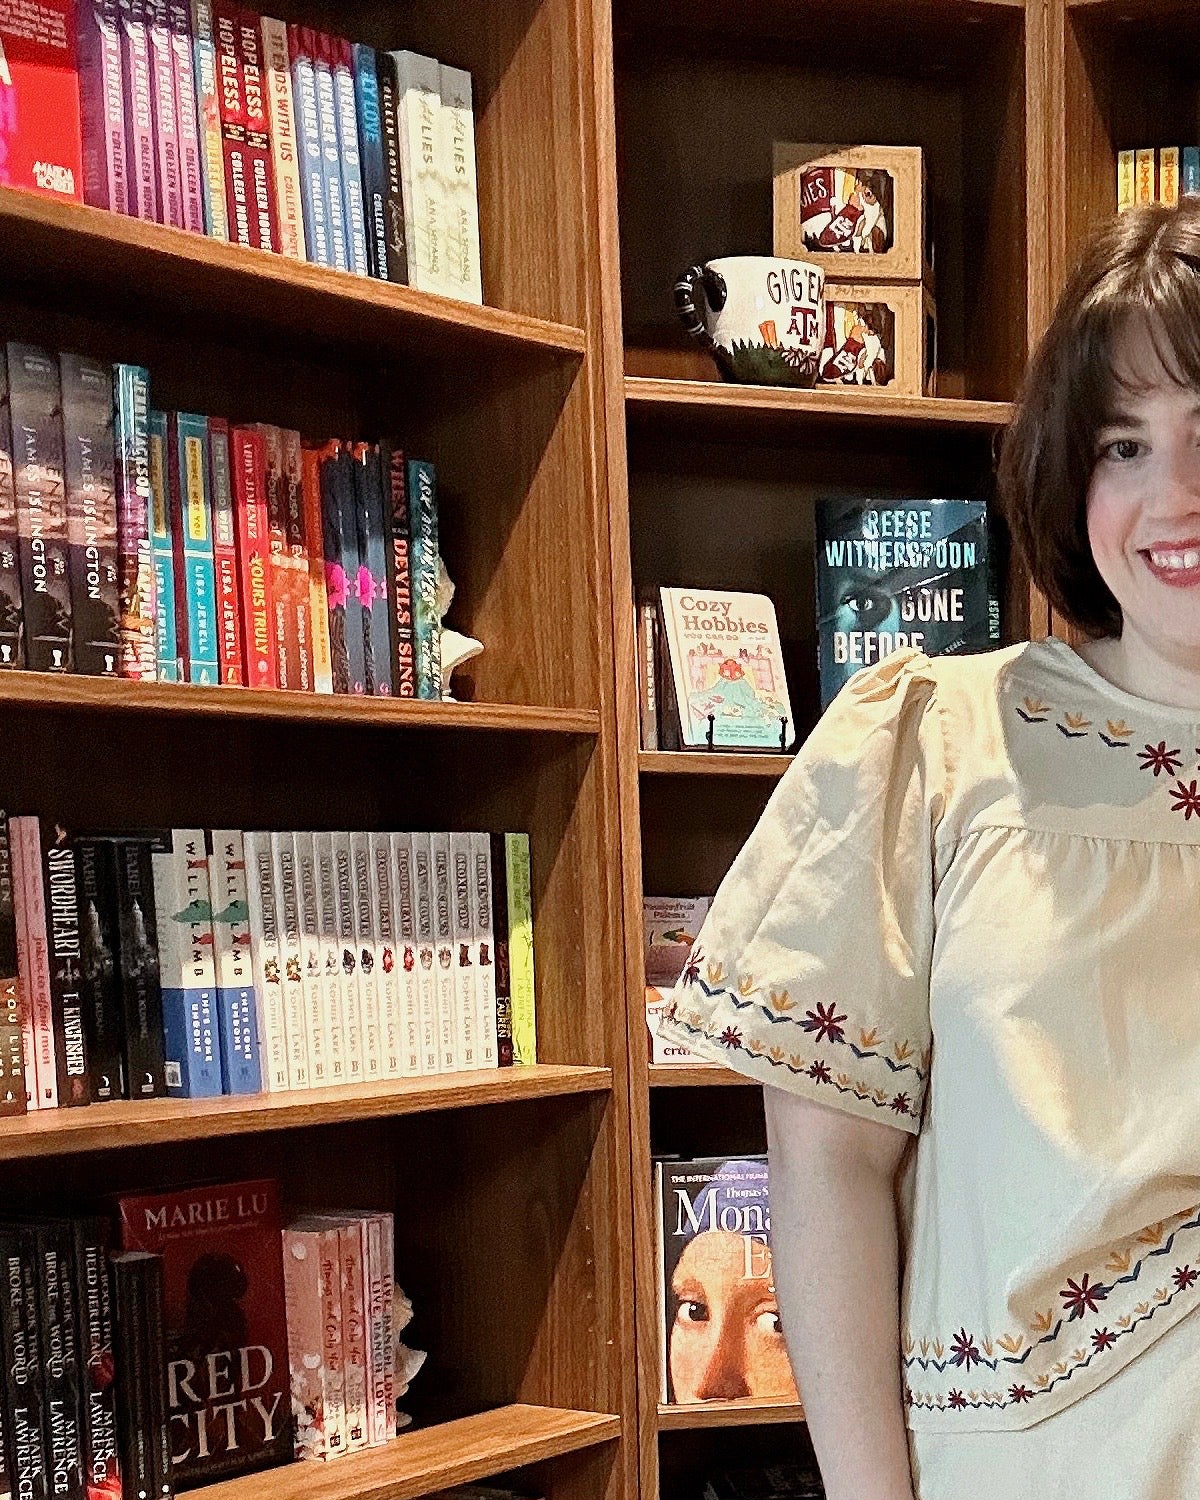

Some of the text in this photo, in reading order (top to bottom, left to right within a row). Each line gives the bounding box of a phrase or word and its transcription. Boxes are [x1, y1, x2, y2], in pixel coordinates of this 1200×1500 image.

[219, 17, 241, 112] HOPELESS
[241, 27, 263, 119] HOPELESS
[767, 268, 803, 305] GIG
[23, 425, 48, 593] JAMES ISLINGTON
[79, 435, 101, 600] JAMES ISLINGTON
[864, 510, 932, 539] REESE
[393, 538, 412, 625] DEVILS
[825, 539, 977, 570] WITHERSPOON
[223, 601, 235, 659] JEWELL
[249, 551, 268, 654] YOURS TRULY
[680, 595, 732, 614] Cozy
[683, 615, 769, 635] Hobbies
[901, 589, 965, 621] GONE
[398, 642, 414, 697] SING
[833, 632, 926, 664] BEFORE
[48, 848, 81, 959] SWORDHEART
[191, 922, 203, 977] LAMB
[63, 1007, 85, 1077] KINGFISHER
[497, 997, 507, 1038] LAUREN
[145, 1193, 268, 1231] MARIE LU
[727, 1186, 761, 1199] Thomas
[11, 1331, 27, 1384] WORLD
[46, 1324, 63, 1378] WORLD
[167, 1344, 275, 1408] RED
[51, 1402, 68, 1493] LAWRENCE
[63, 1420, 78, 1471] MARK
[90, 1391, 106, 1484] LAWRENCE
